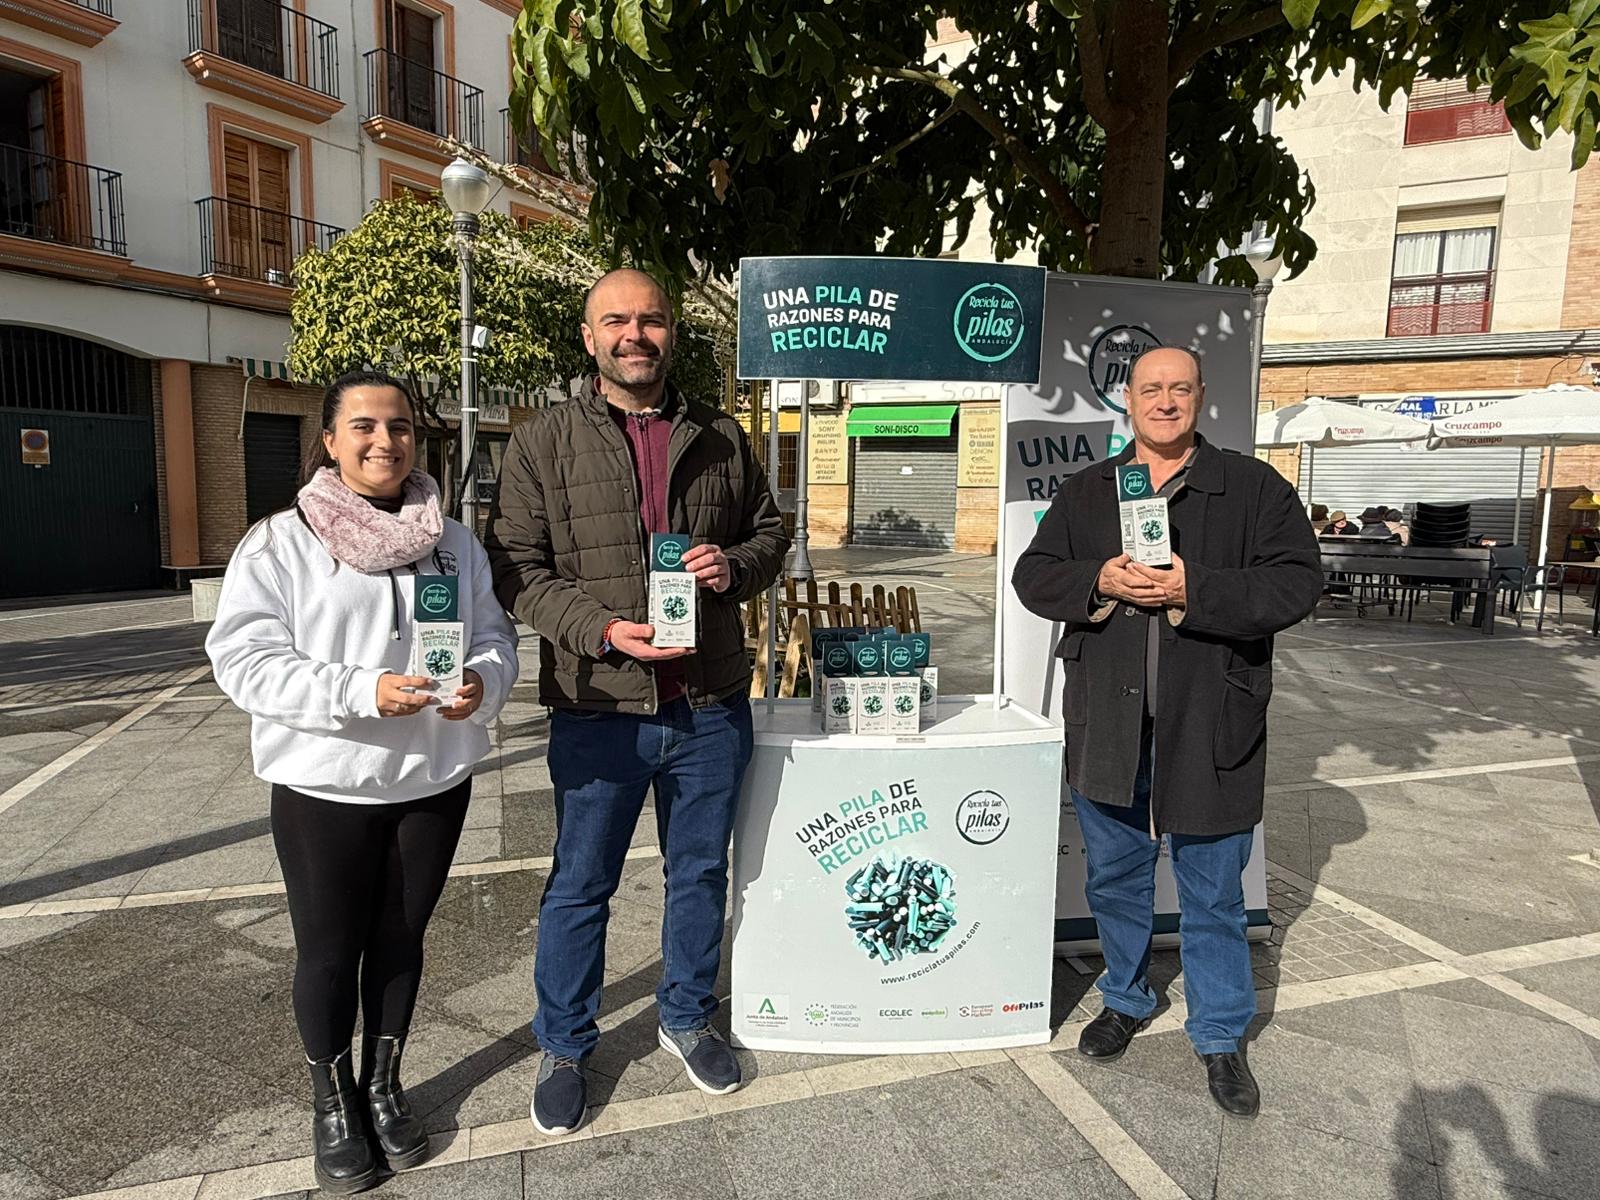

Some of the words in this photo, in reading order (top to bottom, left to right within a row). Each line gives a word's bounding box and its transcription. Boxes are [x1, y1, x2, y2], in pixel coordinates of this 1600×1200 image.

[763, 287, 809, 310] UNA
[815, 285, 862, 305] PILA
[868, 289, 899, 312] DE
[969, 296, 999, 308] Recicla
[1001, 298, 1015, 309] tus
[767, 307, 844, 329] RAZONES
[848, 308, 892, 330] PARA
[965, 308, 1014, 343] pilas
[770, 326, 888, 355] RECICLAR
[1105, 338, 1139, 353] Recicla
[874, 425, 919, 434] SONI-DISCO
[1444, 421, 1502, 430] Cruzcampo
[1017, 434, 1096, 468] UNA
[795, 811, 839, 844] UNA
[838, 788, 886, 818] PILA
[888, 778, 918, 800] DE
[965, 808, 1002, 833] pilas
[807, 811, 876, 857] RAZONES
[878, 796, 923, 820] PARA
[816, 810, 929, 875] RECICLAR
[880, 920, 982, 985] www.reciclatuspilas.com
[879, 1009, 913, 1017] ECOLEC
